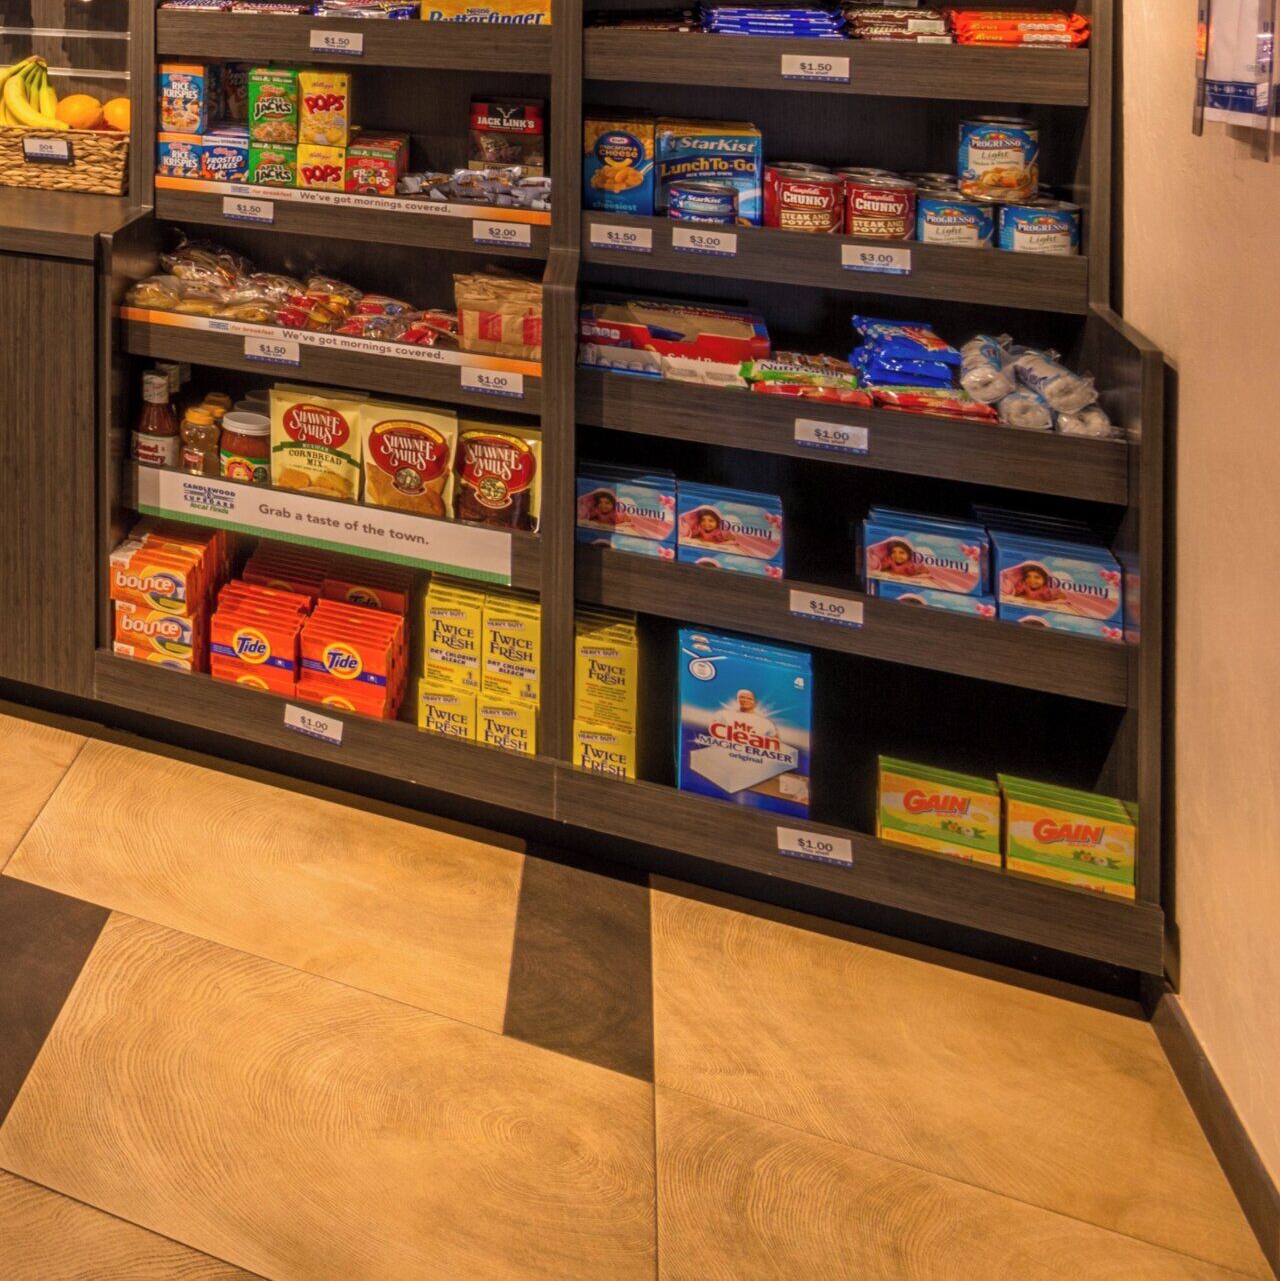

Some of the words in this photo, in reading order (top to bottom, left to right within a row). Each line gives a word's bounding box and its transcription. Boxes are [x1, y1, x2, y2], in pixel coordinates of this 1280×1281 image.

[324, 37, 350, 46] $1.50
[799, 61, 833, 72] $1.50
[163, 87, 199, 101] KRISPIES
[171, 82, 189, 92] RICE
[261, 96, 285, 104] APPLE
[304, 93, 346, 115] POPS
[254, 101, 292, 120] JACKS
[477, 116, 502, 126] JACK
[503, 118, 535, 129] LINK'S
[679, 137, 757, 154] StarKist
[970, 138, 1022, 149] PROGRESSO
[162, 156, 198, 169] KRISPIES
[171, 150, 189, 160] RICE
[206, 154, 243, 166] FROSTED
[981, 150, 1011, 161] Light
[208, 161, 238, 170] FLAKES
[302, 165, 343, 185] POPS
[353, 169, 388, 179] FROOT
[358, 176, 391, 187] LOOPS
[300, 192, 331, 204] We've
[333, 195, 352, 207] got
[353, 197, 402, 211] mornings
[404, 201, 452, 214] covered.
[687, 194, 722, 204] StarKist
[782, 192, 830, 208] CHUNKY
[855, 197, 904, 215] CHUNKY
[781, 212, 811, 222] STEAK
[812, 213, 831, 222] AND
[781, 217, 830, 227] POTATO
[926, 214, 976, 225] PROGRESSO
[689, 235, 721, 246] $3.00
[282, 329, 315, 344] We've
[317, 336, 339, 349] got
[340, 337, 392, 355] mornings
[394, 344, 446, 361] covered.
[290, 409, 343, 437] SHAWNEE
[297, 423, 333, 446] MILLS
[380, 433, 437, 462] SHAWNEE
[288, 449, 342, 466] CORNBREAD
[306, 458, 323, 468] MIX
[190, 502, 208, 512] local
[209, 504, 230, 515] finds
[616, 501, 666, 523] Downy
[259, 503, 292, 519] Grab
[295, 512, 304, 521] a
[306, 514, 340, 528] taste
[344, 520, 359, 532] of
[362, 523, 385, 537] the
[389, 529, 429, 545] town.
[719, 520, 773, 542] Downy
[116, 572, 174, 593] bounce
[432, 619, 474, 638] TWICE
[236, 636, 267, 655] Tide
[432, 631, 474, 651] FRESH
[489, 630, 533, 650] TWICE
[327, 652, 358, 670] Tide
[430, 647, 442, 655] DRY
[445, 651, 477, 663] CHLORINE
[441, 655, 466, 665] BLEACH
[734, 720, 756, 734] Mr.
[710, 723, 780, 751] Clean
[696, 733, 742, 752] MAGIC
[745, 746, 793, 763] ERASER
[728, 751, 763, 764] original
[903, 789, 970, 815] GAIN
[1032, 818, 1105, 844] GAIN
